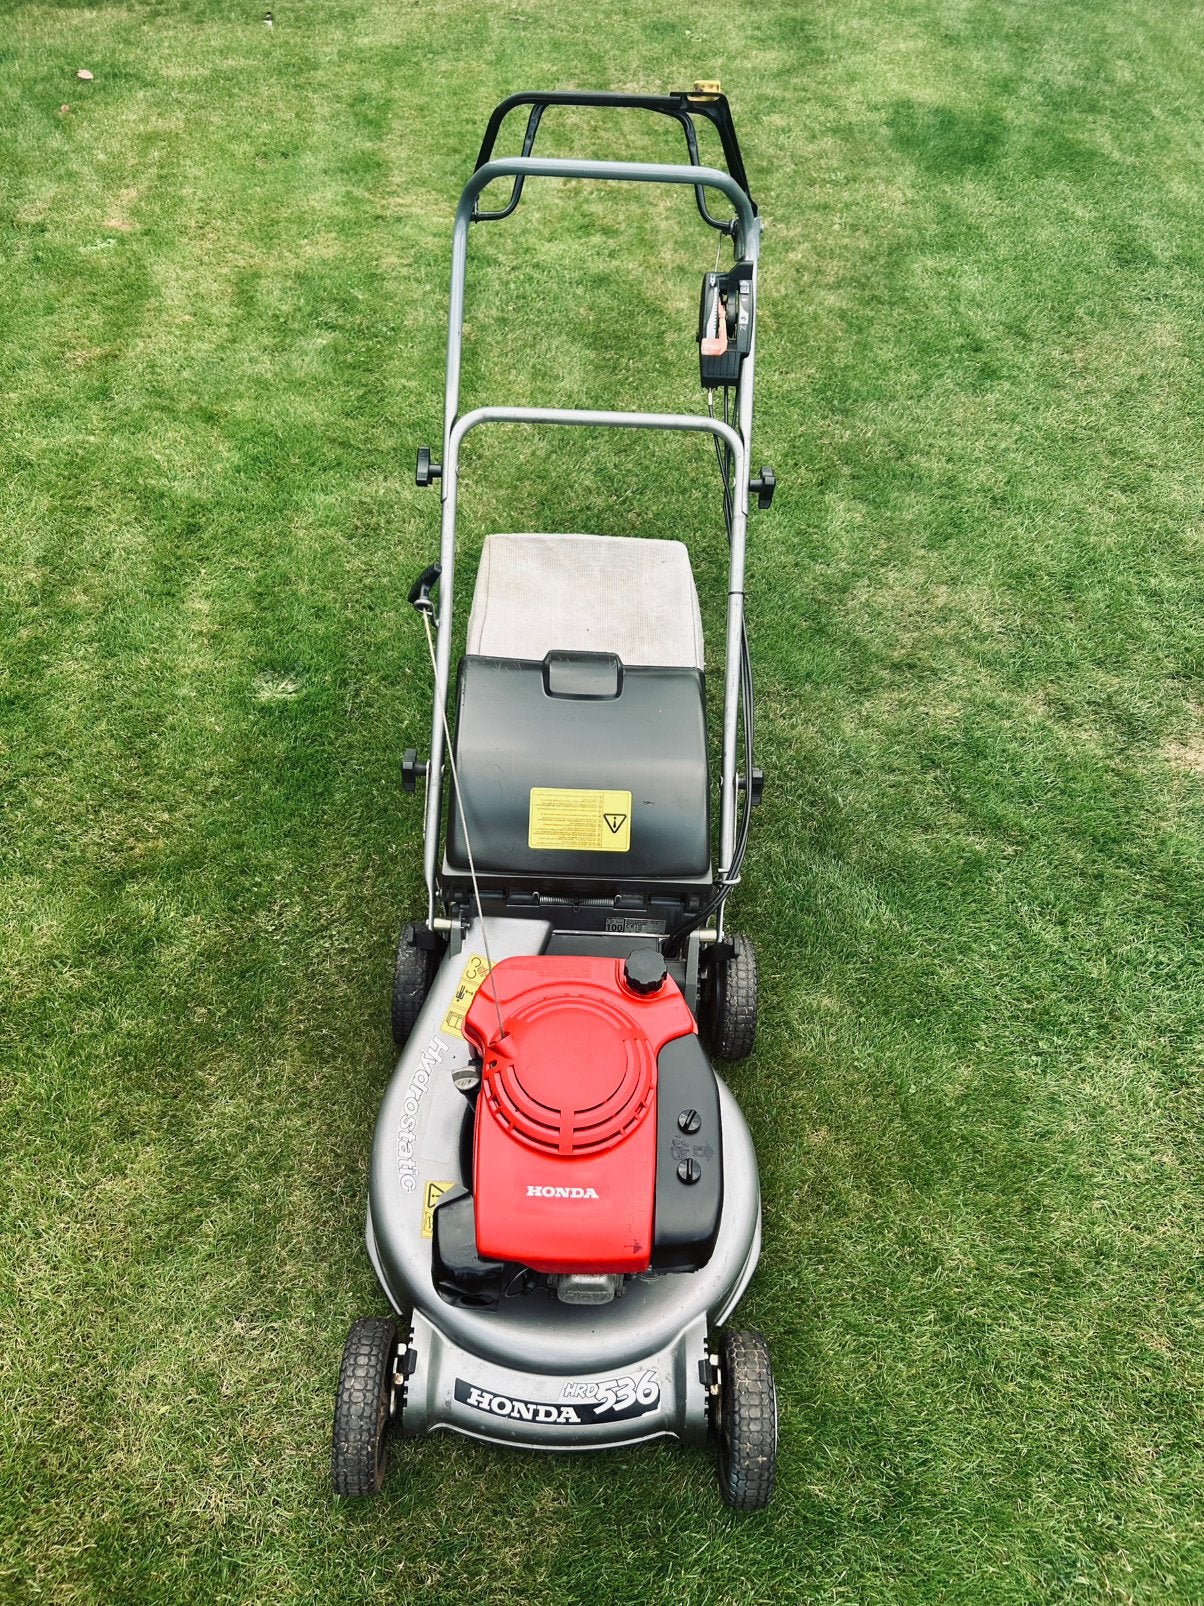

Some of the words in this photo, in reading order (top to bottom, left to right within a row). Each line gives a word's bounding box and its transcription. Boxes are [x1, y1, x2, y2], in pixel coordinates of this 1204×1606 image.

[606, 923, 623, 932] 100
[398, 1034, 449, 1192] Hydrostatic
[526, 1185, 600, 1199] HONDA
[467, 1387, 581, 1424] HONDA
